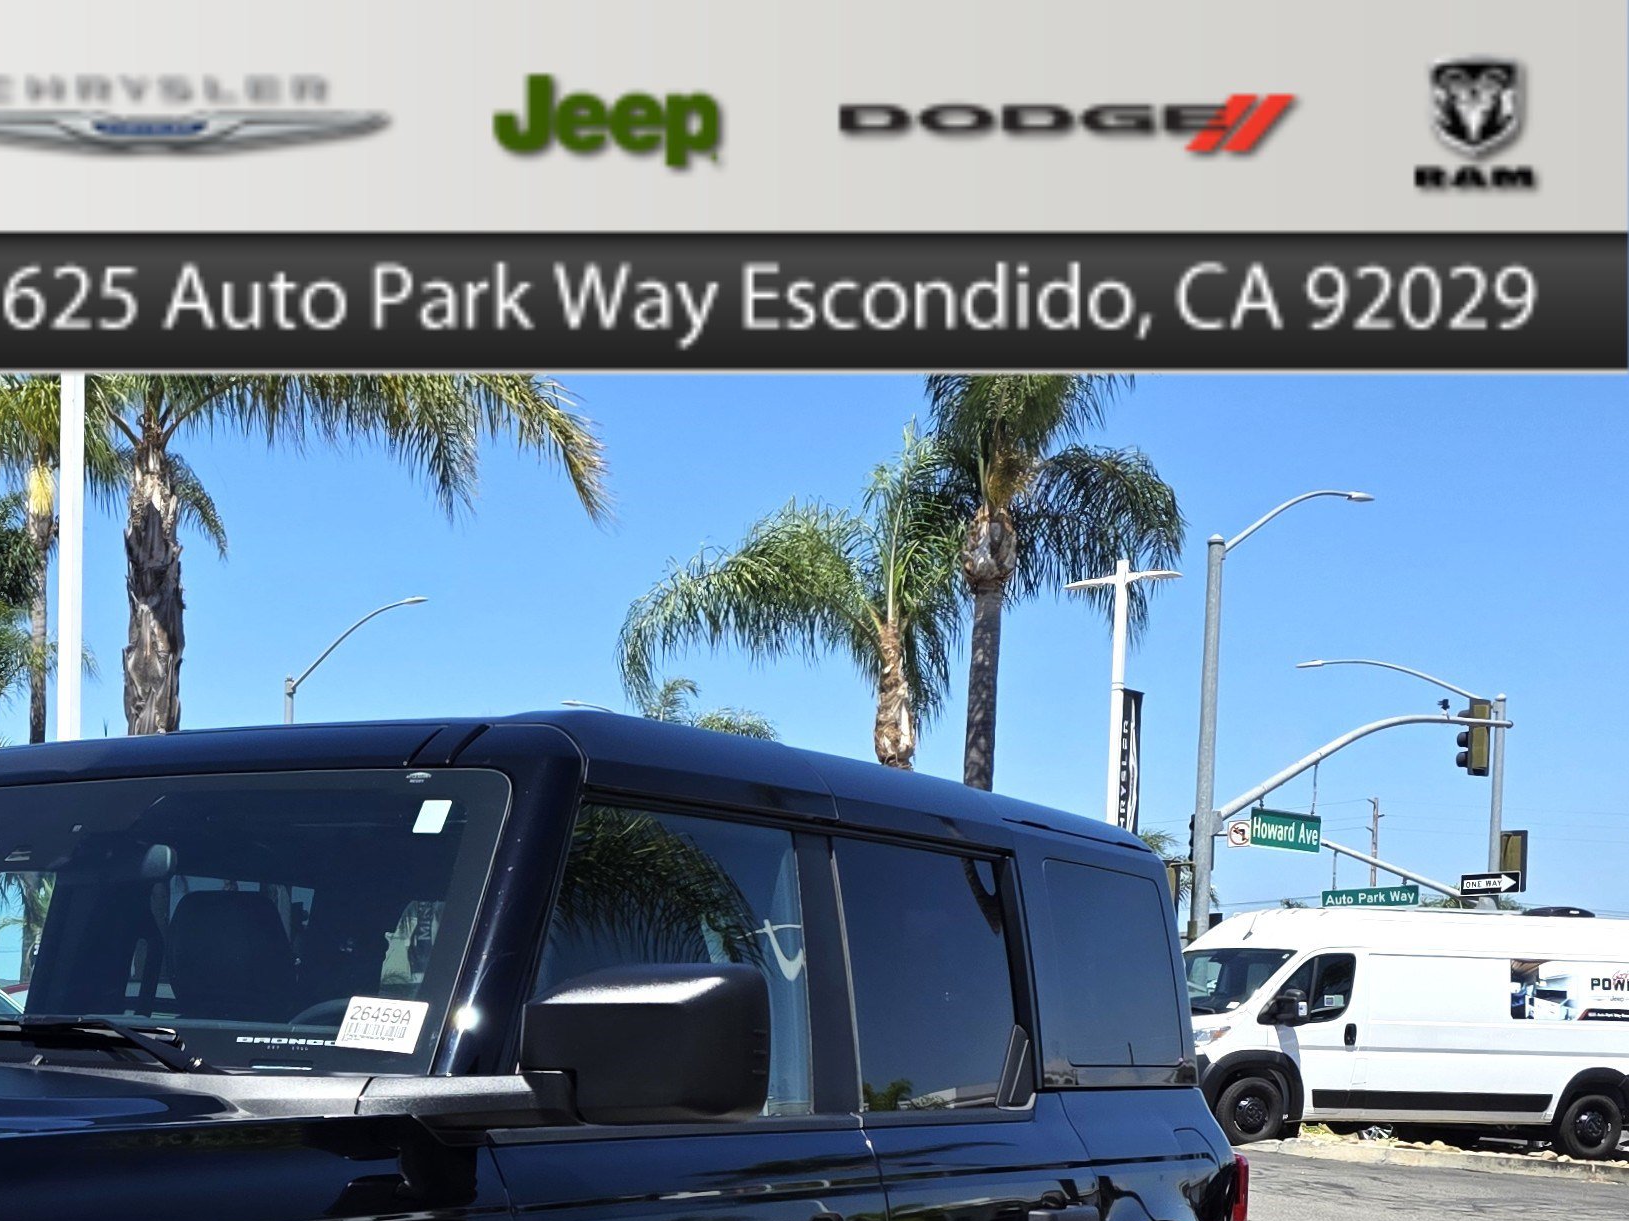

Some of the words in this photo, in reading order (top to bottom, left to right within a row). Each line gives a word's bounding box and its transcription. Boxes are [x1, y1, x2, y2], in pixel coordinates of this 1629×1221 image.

[1252, 816, 1295, 843] Howard
[1298, 825, 1319, 846] Ave
[1465, 880, 1483, 888] ONE
[1484, 879, 1502, 888] WAY
[1325, 893, 1354, 906] Auto
[1358, 891, 1386, 904] Park
[1389, 890, 1415, 905] Way
[1590, 977, 1629, 991] POW
[350, 1005, 412, 1025] 26459A
